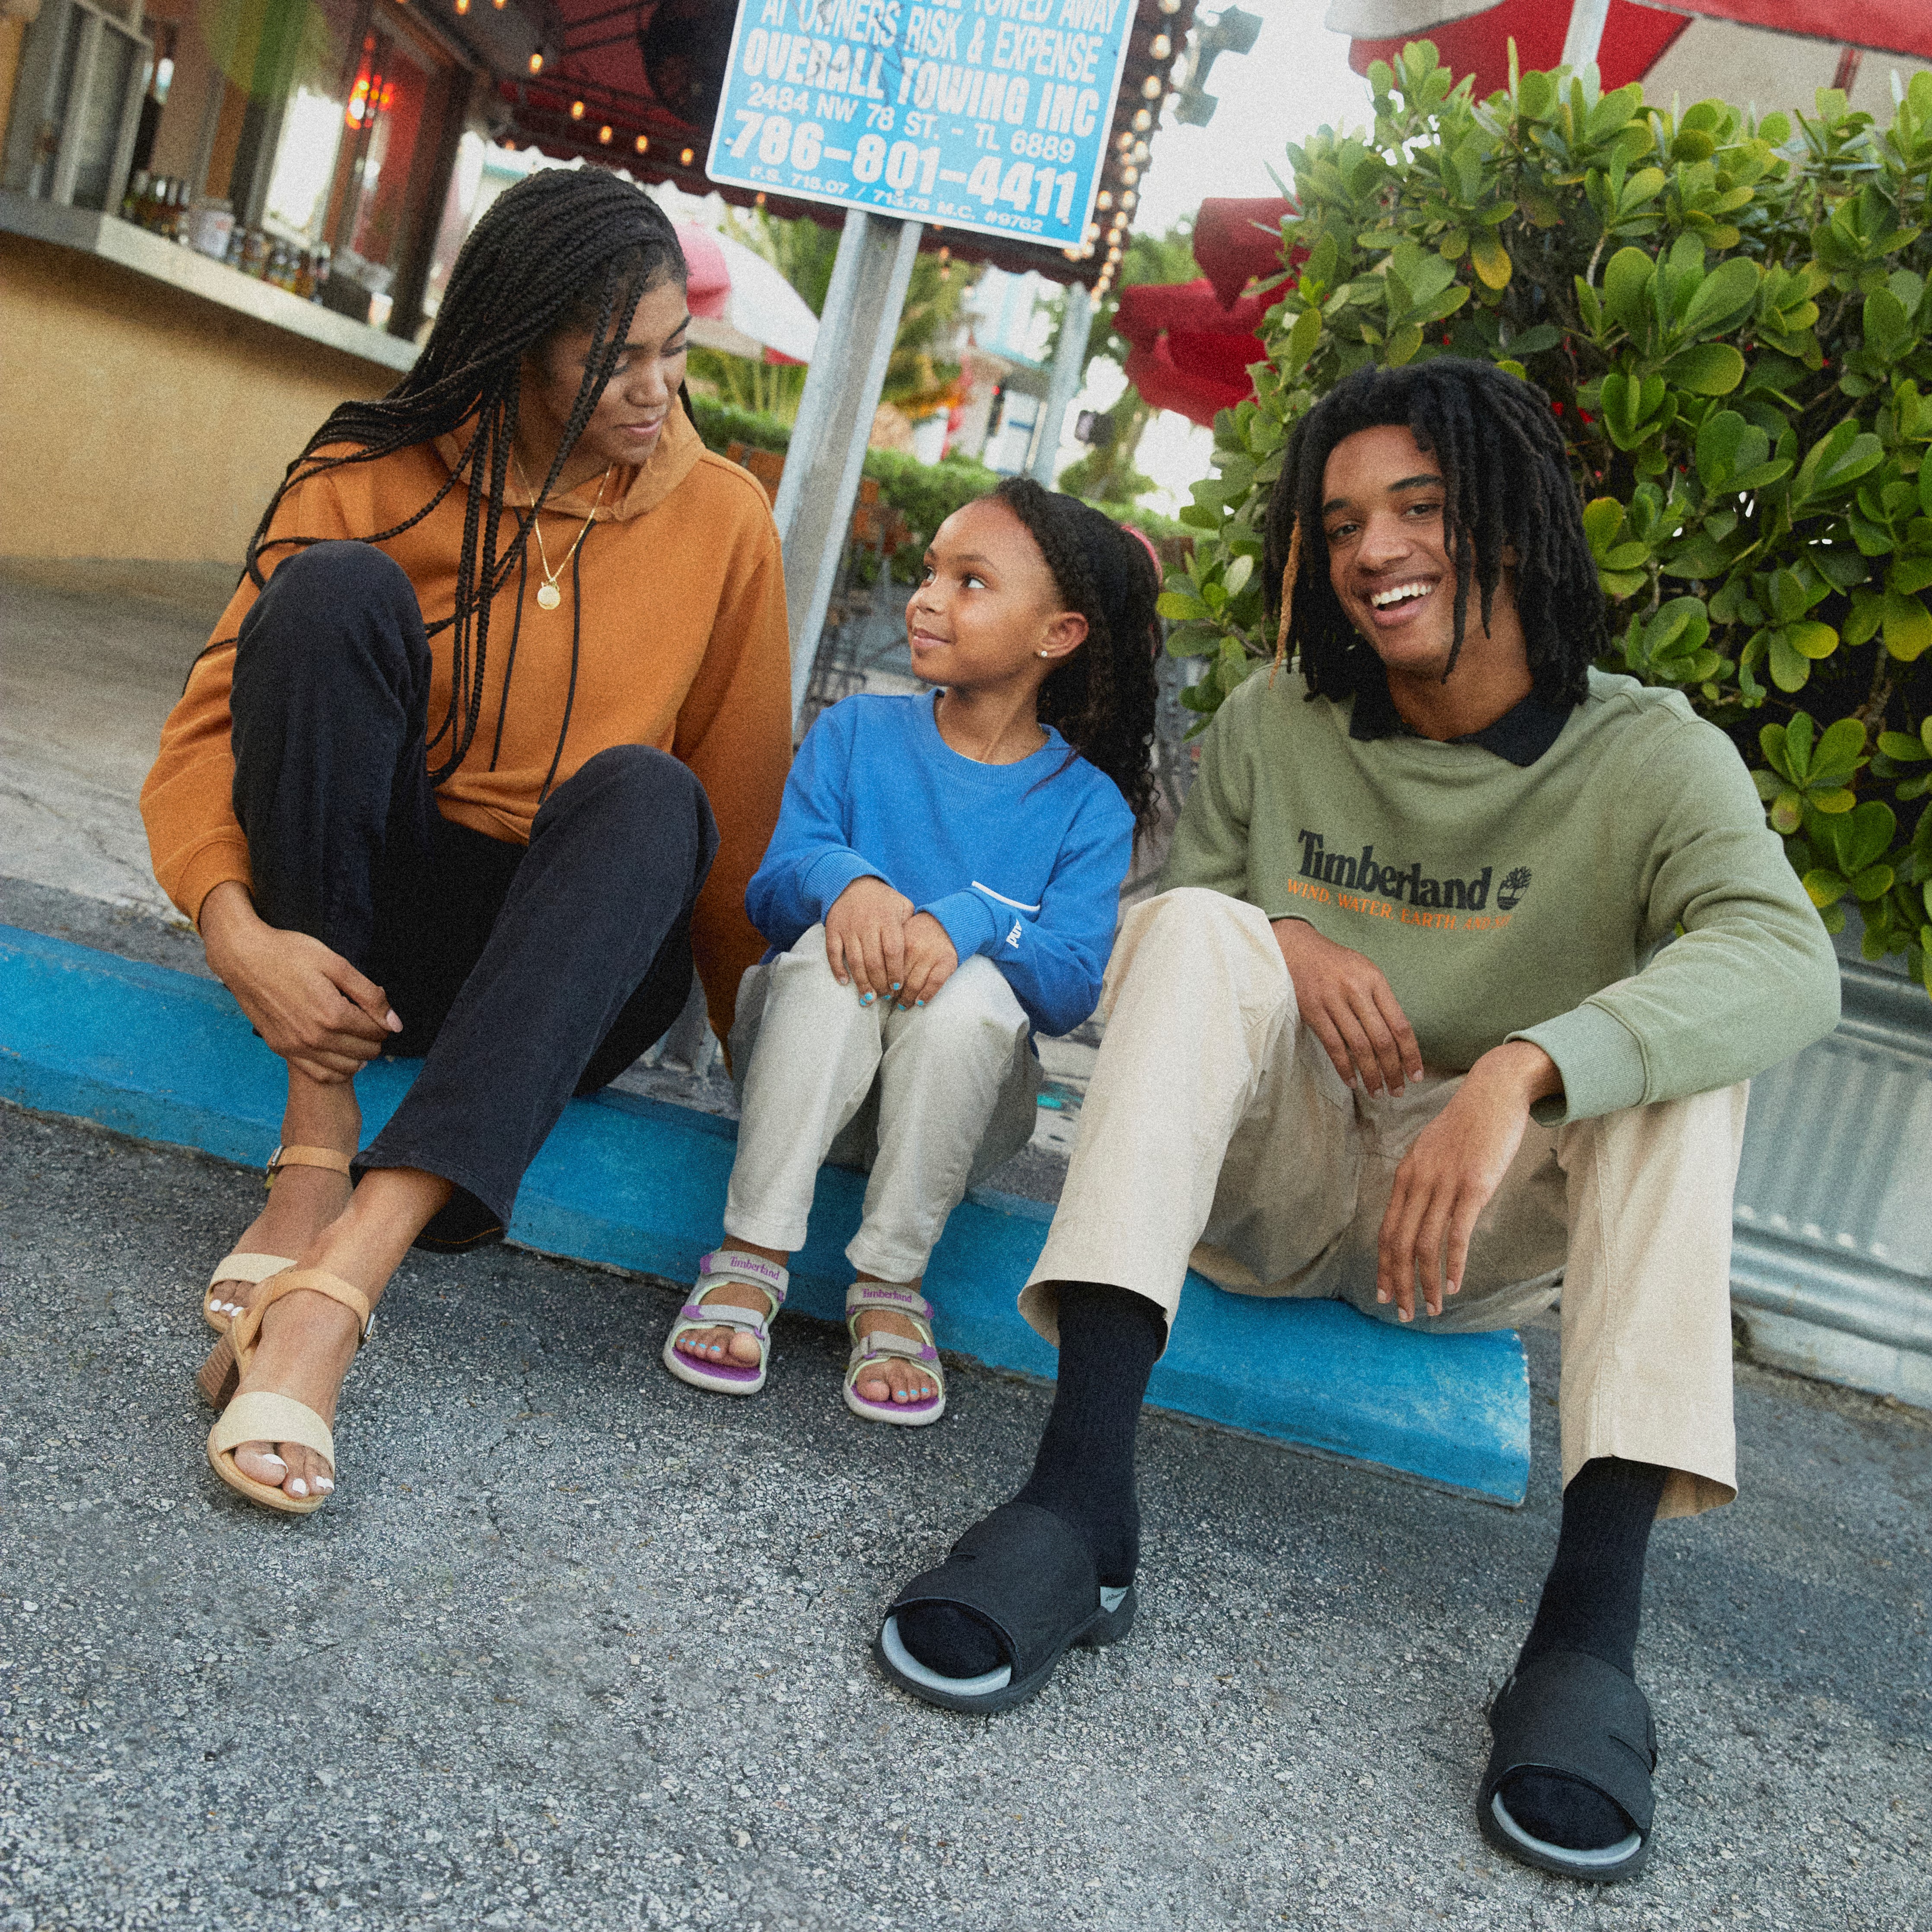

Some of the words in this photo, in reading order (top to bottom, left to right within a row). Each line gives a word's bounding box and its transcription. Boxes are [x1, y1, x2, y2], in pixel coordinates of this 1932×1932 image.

[799, 0, 901, 48] OWNERS
[904, 6, 963, 60] RISK
[967, 17, 986, 64] &
[993, 21, 1103, 83] EXPENSE
[1058, 0, 1120, 34] AWAY
[742, 28, 884, 99] OVERALL
[897, 57, 1029, 125] TOWING
[1035, 82, 1099, 137] INC
[747, 82, 809, 115] 2484
[816, 93, 859, 123] NW
[866, 103, 895, 131] 78
[904, 111, 940, 140] ST.
[974, 123, 1000, 150] TL
[1010, 130, 1076, 163] 6889
[936, 201, 975, 220] M.C.
[1298, 828, 1493, 911] Timberland
[730, 1256, 780, 1280] Timberland
[862, 1288, 912, 1303] Timberland
